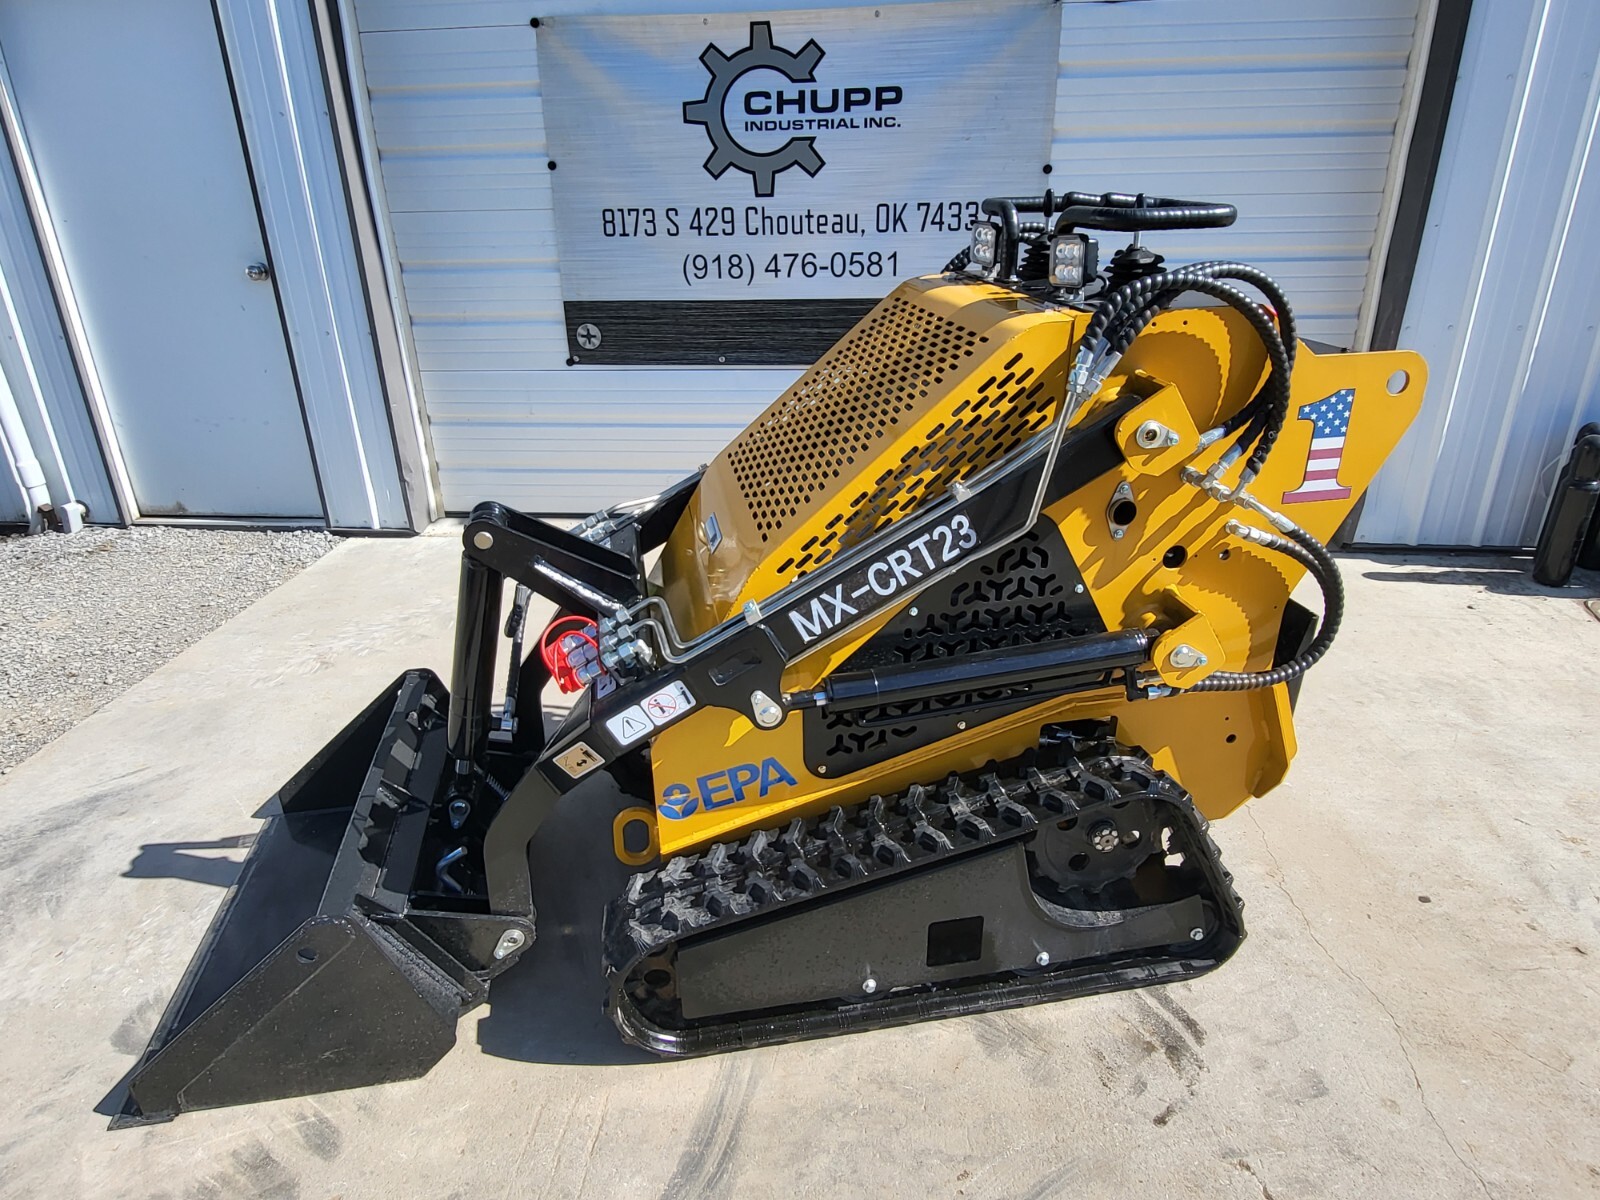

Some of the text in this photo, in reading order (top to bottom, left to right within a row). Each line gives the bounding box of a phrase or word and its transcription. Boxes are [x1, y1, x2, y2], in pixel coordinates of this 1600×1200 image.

[744, 86, 903, 115] CHUPP
[744, 117, 902, 132] INDUSTRIAL INC.
[602, 201, 993, 237] 8173 S 429 Chouteau, OK 7433
[683, 251, 898, 286] (918) 476-0581
[788, 514, 977, 643] MX-CRT23
[696, 756, 798, 811] EPA
